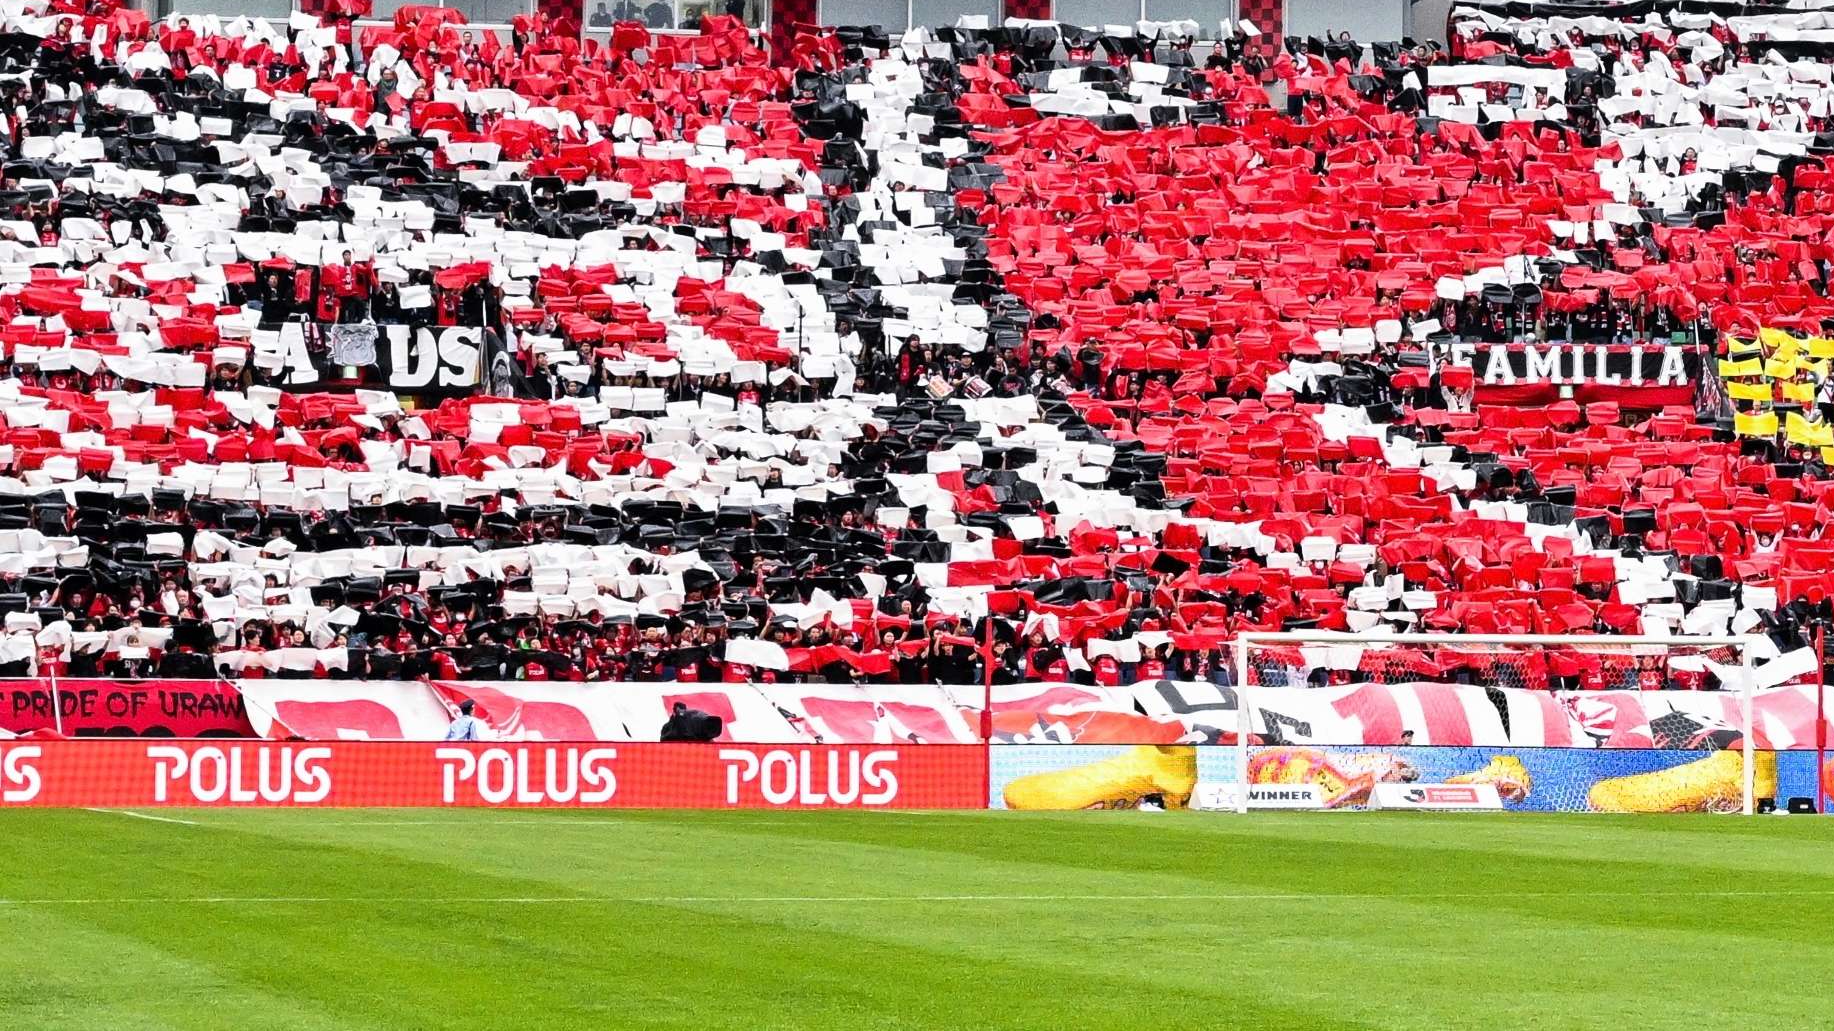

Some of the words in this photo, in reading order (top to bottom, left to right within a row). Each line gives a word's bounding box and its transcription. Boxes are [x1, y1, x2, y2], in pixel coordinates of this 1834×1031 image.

[1451, 343, 1688, 386] FAMILIA
[106, 690, 149, 719] OF
[147, 746, 332, 803] POLUS
[435, 747, 617, 804] POLUS
[719, 749, 899, 805] POLUS
[1249, 790, 1313, 801] WINNER
